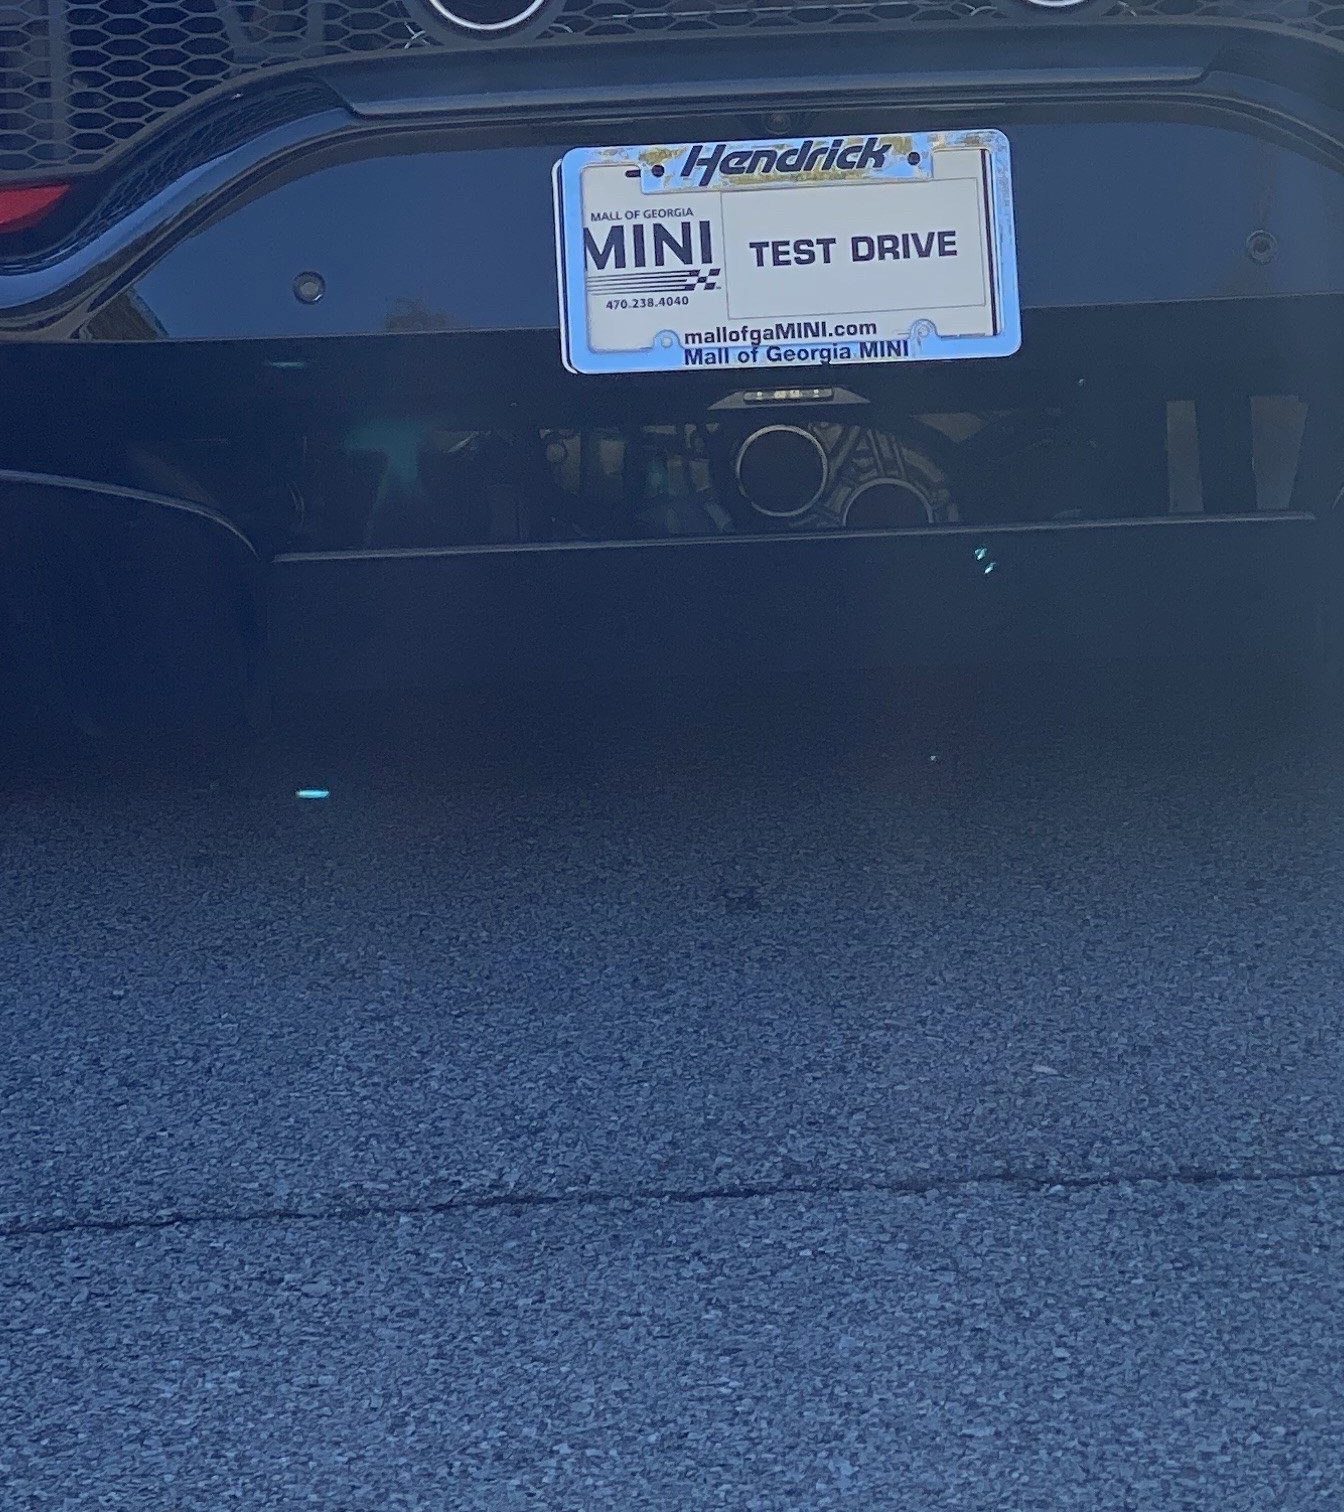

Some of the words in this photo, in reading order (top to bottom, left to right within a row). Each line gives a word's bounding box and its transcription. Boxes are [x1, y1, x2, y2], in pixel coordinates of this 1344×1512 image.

[679, 137, 893, 187] Hendrick
[591, 210, 622, 222] MALL
[624, 209, 641, 220] OF
[643, 207, 694, 219] GEORGIA
[583, 220, 713, 272] MINI
[749, 238, 837, 268] TEST
[851, 230, 958, 263] DRIVE
[606, 295, 690, 310] 470.238.4040
[684, 321, 878, 346] mallofgaMINI.com
[684, 347, 730, 366] Mall
[737, 346, 759, 363] of
[766, 342, 852, 365] Georgia
[859, 339, 910, 359] MINI
